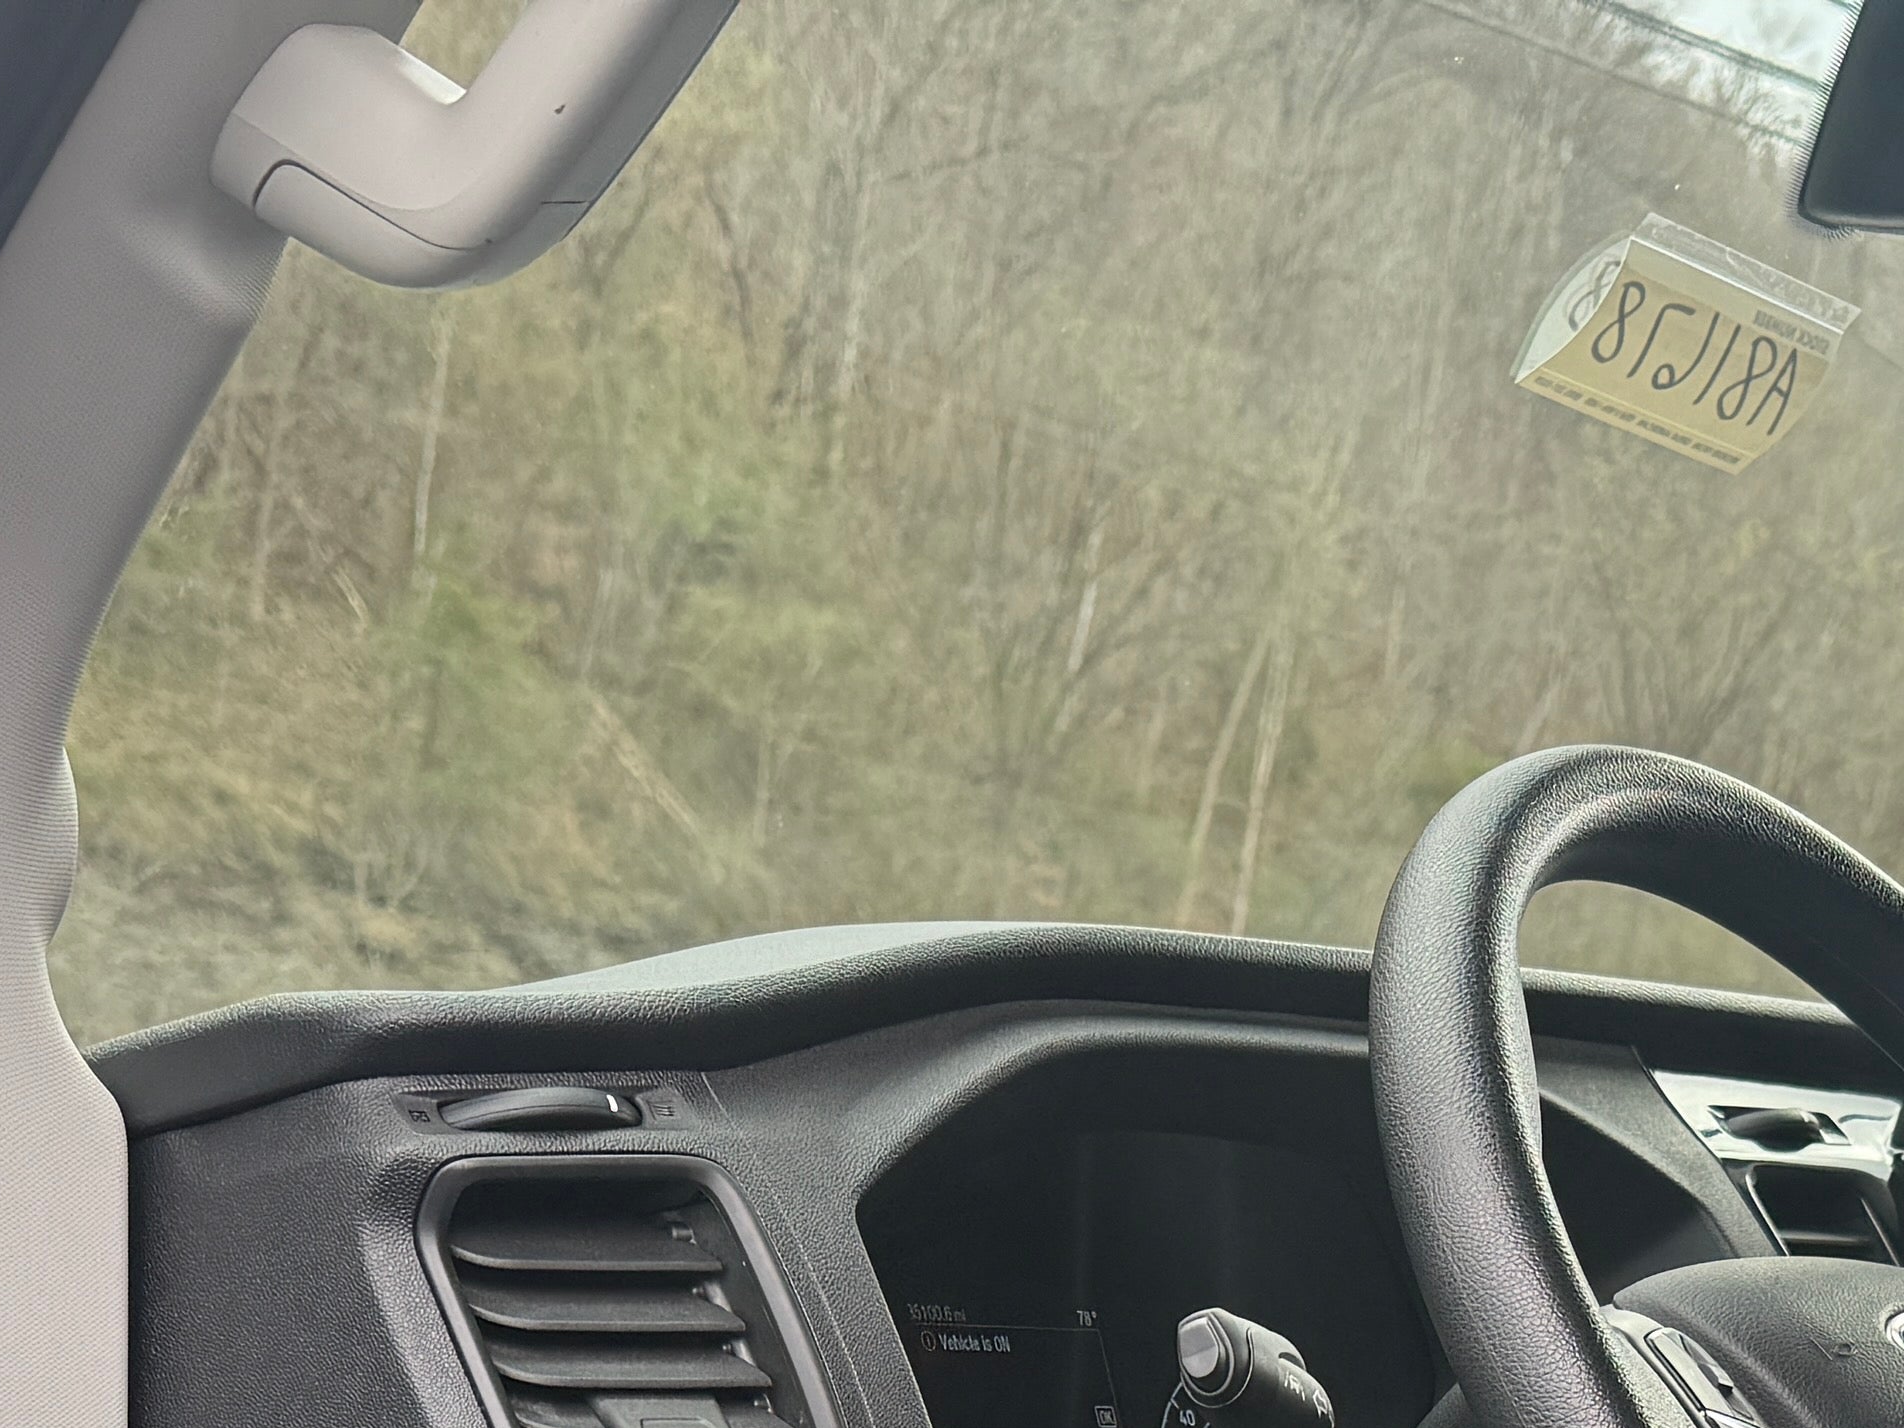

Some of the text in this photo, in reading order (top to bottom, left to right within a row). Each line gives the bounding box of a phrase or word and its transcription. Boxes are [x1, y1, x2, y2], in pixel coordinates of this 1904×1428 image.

[938, 1333, 1011, 1353] Vehicle is ON
[1179, 1410, 1195, 1427] 40
